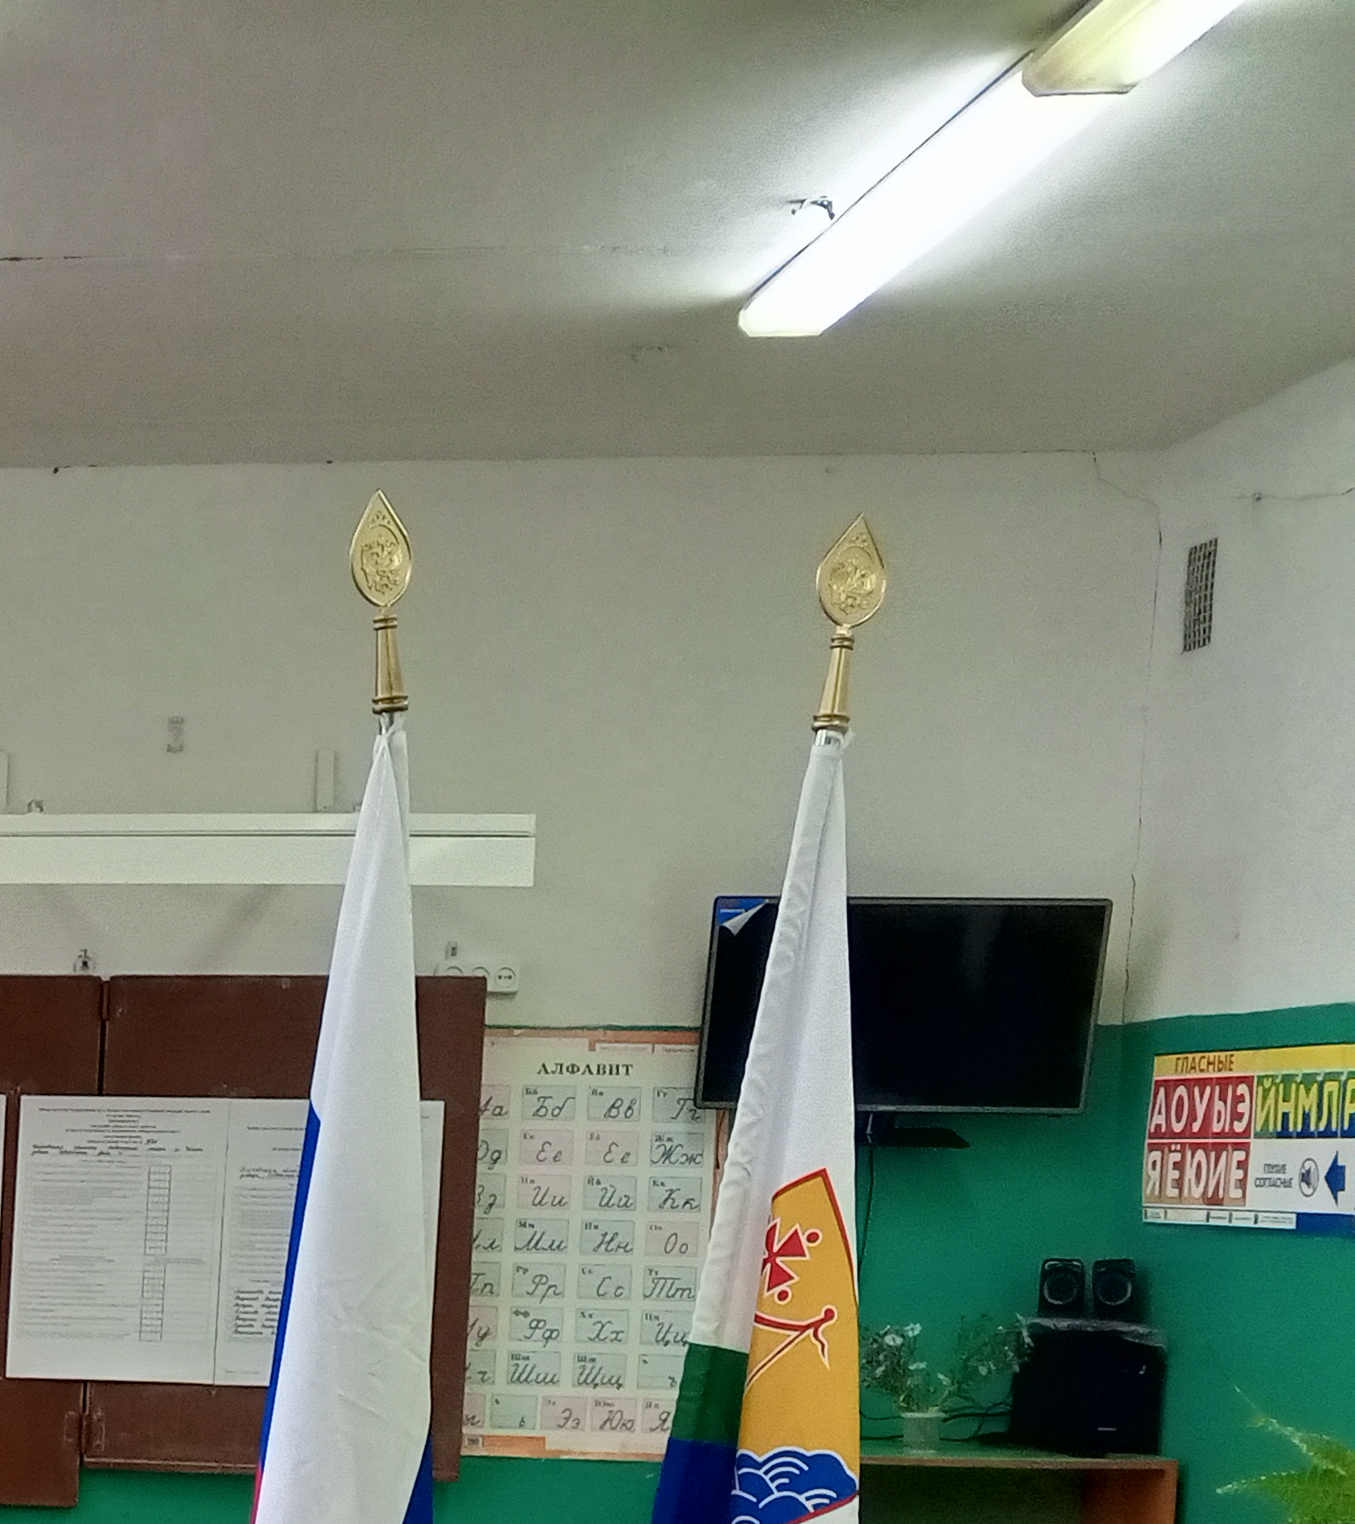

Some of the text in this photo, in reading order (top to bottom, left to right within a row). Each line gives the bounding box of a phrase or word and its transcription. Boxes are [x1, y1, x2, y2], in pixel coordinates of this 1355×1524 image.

[537, 1062, 634, 1077] АЛФАВИТ
[1174, 1053, 1235, 1074] ГЛАСНЫЕ
[603, 1097, 637, 1119] Вв
[650, 1143, 704, 1165] Жж
[531, 1185, 568, 1207] Ии
[514, 1230, 568, 1251] Мм
[592, 1231, 634, 1253] Нн
[663, 1232, 690, 1254] Оо
[525, 1273, 562, 1304] Рр
[596, 1275, 626, 1298] Сс
[643, 1276, 696, 1299] Тт
[523, 1318, 560, 1347] Фф
[587, 1320, 625, 1343] Хх
[509, 1363, 560, 1385] Шш
[649, 1410, 671, 1432] Я
